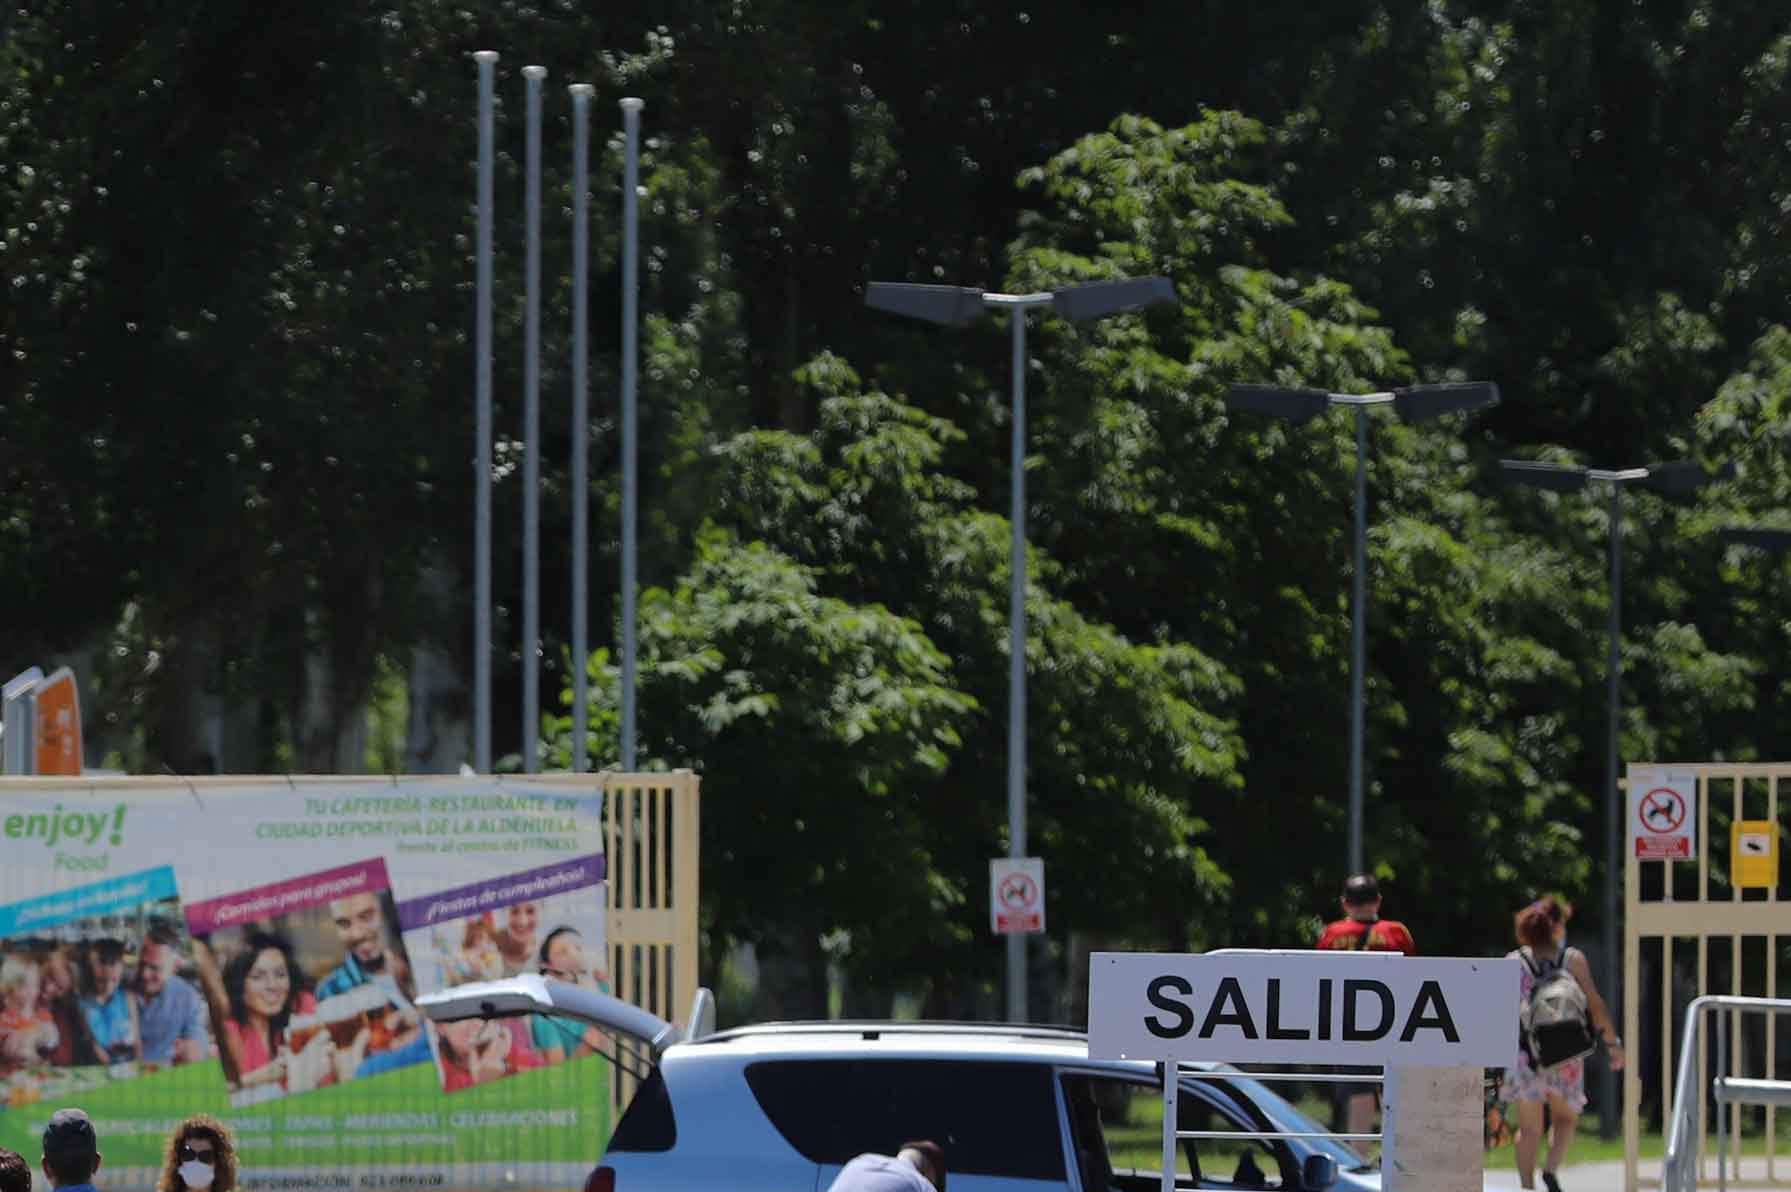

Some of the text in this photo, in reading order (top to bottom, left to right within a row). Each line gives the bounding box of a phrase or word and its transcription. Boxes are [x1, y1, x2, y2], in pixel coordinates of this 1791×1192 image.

[4, 802, 127, 847] enjoy!
[256, 821, 323, 839] CIUDAD
[326, 819, 422, 837] DEPORTIVA
[426, 818, 449, 835] DE
[453, 818, 475, 834] LA
[54, 851, 111, 872] Food
[1143, 974, 1461, 1044] SALIDA
